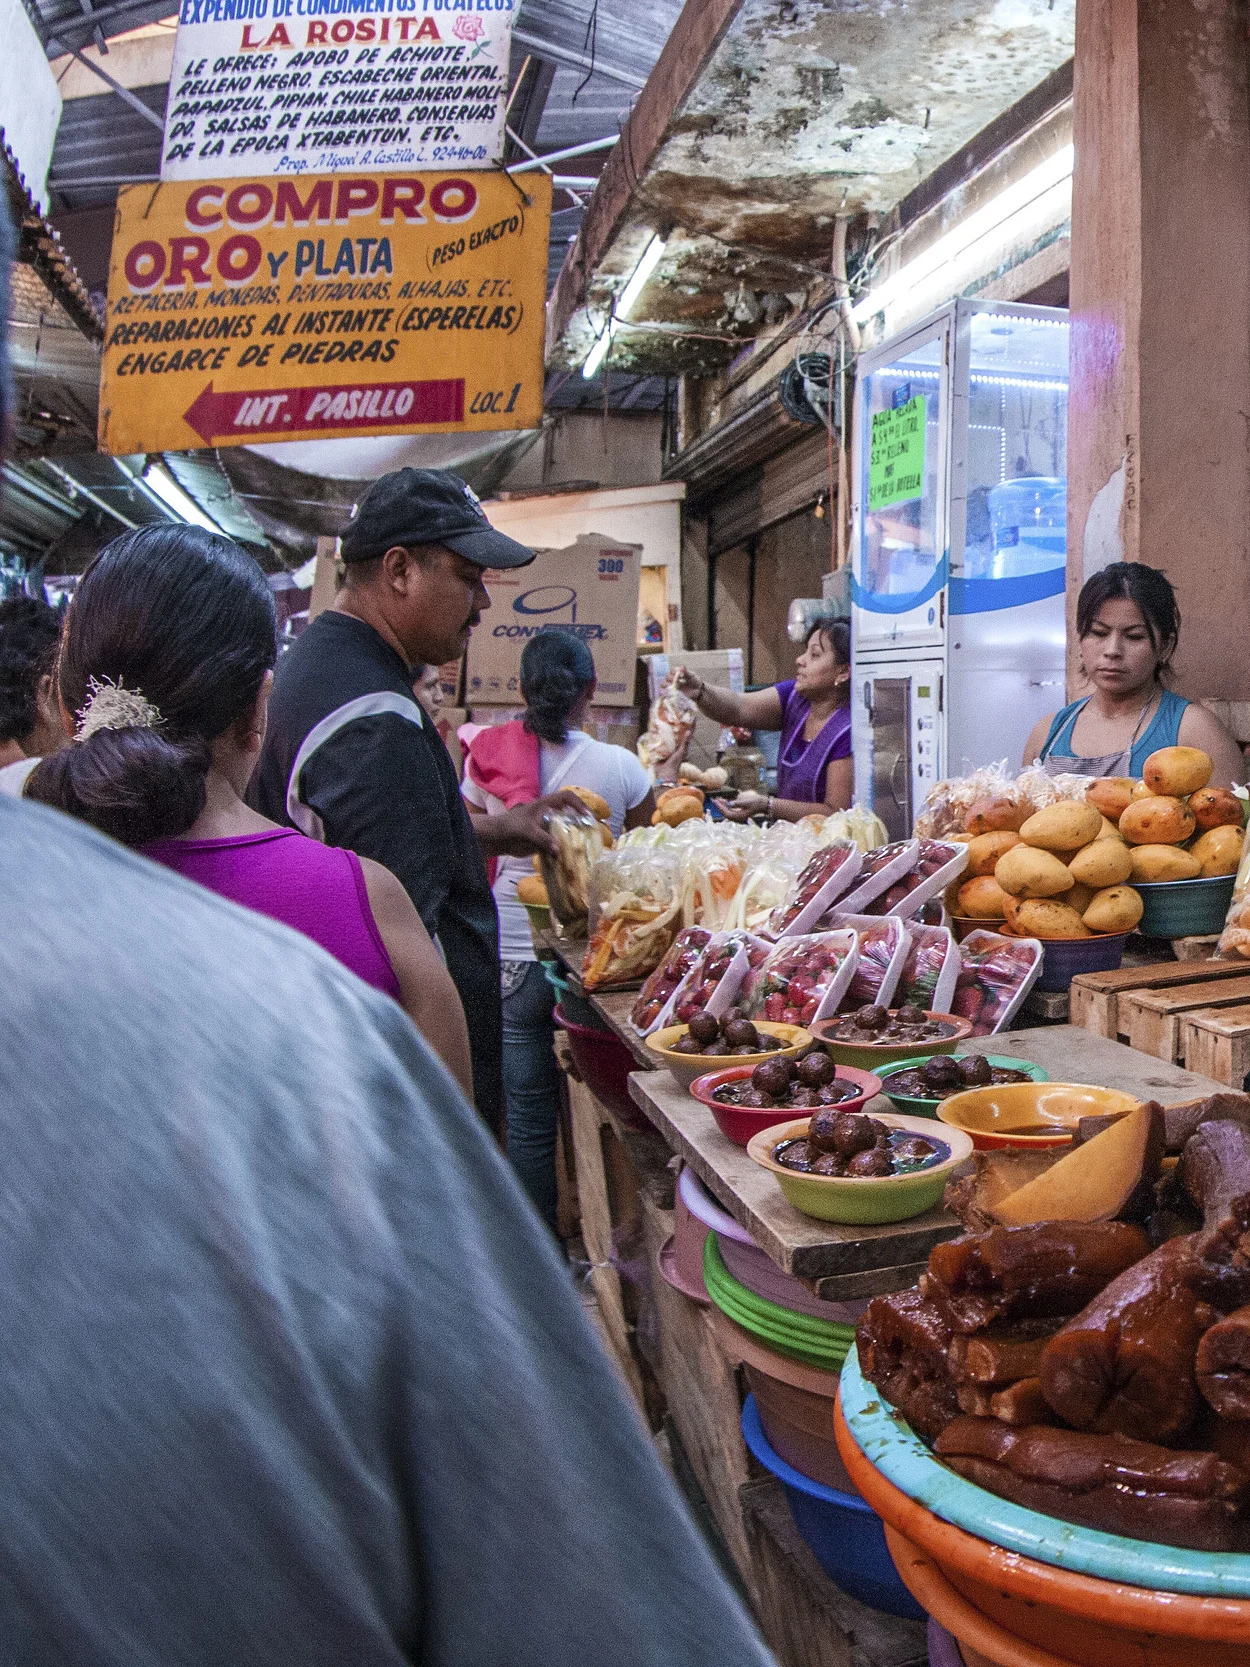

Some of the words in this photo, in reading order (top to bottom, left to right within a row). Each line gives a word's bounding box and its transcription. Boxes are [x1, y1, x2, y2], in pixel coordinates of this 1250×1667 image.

[180, 0, 268, 25] EXPENDIO
[272, 0, 292, 18] DE
[239, 22, 293, 50] LA
[306, 16, 443, 45] ROSITA
[184, 59, 208, 77] LE
[213, 53, 278, 73] OFRECE:
[286, 48, 349, 68] ADOBO
[354, 48, 381, 64] DE
[385, 45, 470, 63] ACHIOTE,
[176, 76, 250, 97] RELLENO
[318, 67, 418, 87] ESCABECHE
[171, 96, 267, 118] PAPADZUL,
[331, 88, 380, 105] CHILE
[379, 86, 463, 104] HABANERO
[204, 114, 271, 136] SALSAS
[276, 112, 301, 129] DE
[166, 142, 195, 161] DE
[199, 139, 225, 156] LA
[230, 134, 289, 154] EPOCA
[419, 126, 460, 141] ETC.
[274, 155, 308, 174] Prop.
[313, 151, 356, 173] Miguel
[373, 147, 413, 164] Castillo
[184, 178, 478, 230] COMPRO
[426, 237, 465, 273] (PESO
[469, 203, 525, 251] EXACTO)
[124, 234, 262, 291] ORO
[294, 237, 393, 278] PLATA
[477, 279, 514, 298] ETC.
[108, 314, 256, 346] REPARACIONES
[260, 311, 292, 336] AL
[293, 308, 395, 335] INSTANTE
[395, 301, 524, 336] (ESPERELAS)
[116, 346, 231, 377] ENGARCE
[237, 343, 275, 368] DE
[280, 338, 400, 366] PIEDRAS
[233, 394, 292, 426] INT.
[305, 388, 415, 422] PASILLO
[504, 383, 522, 413] 1
[597, 558, 625, 573] 300
